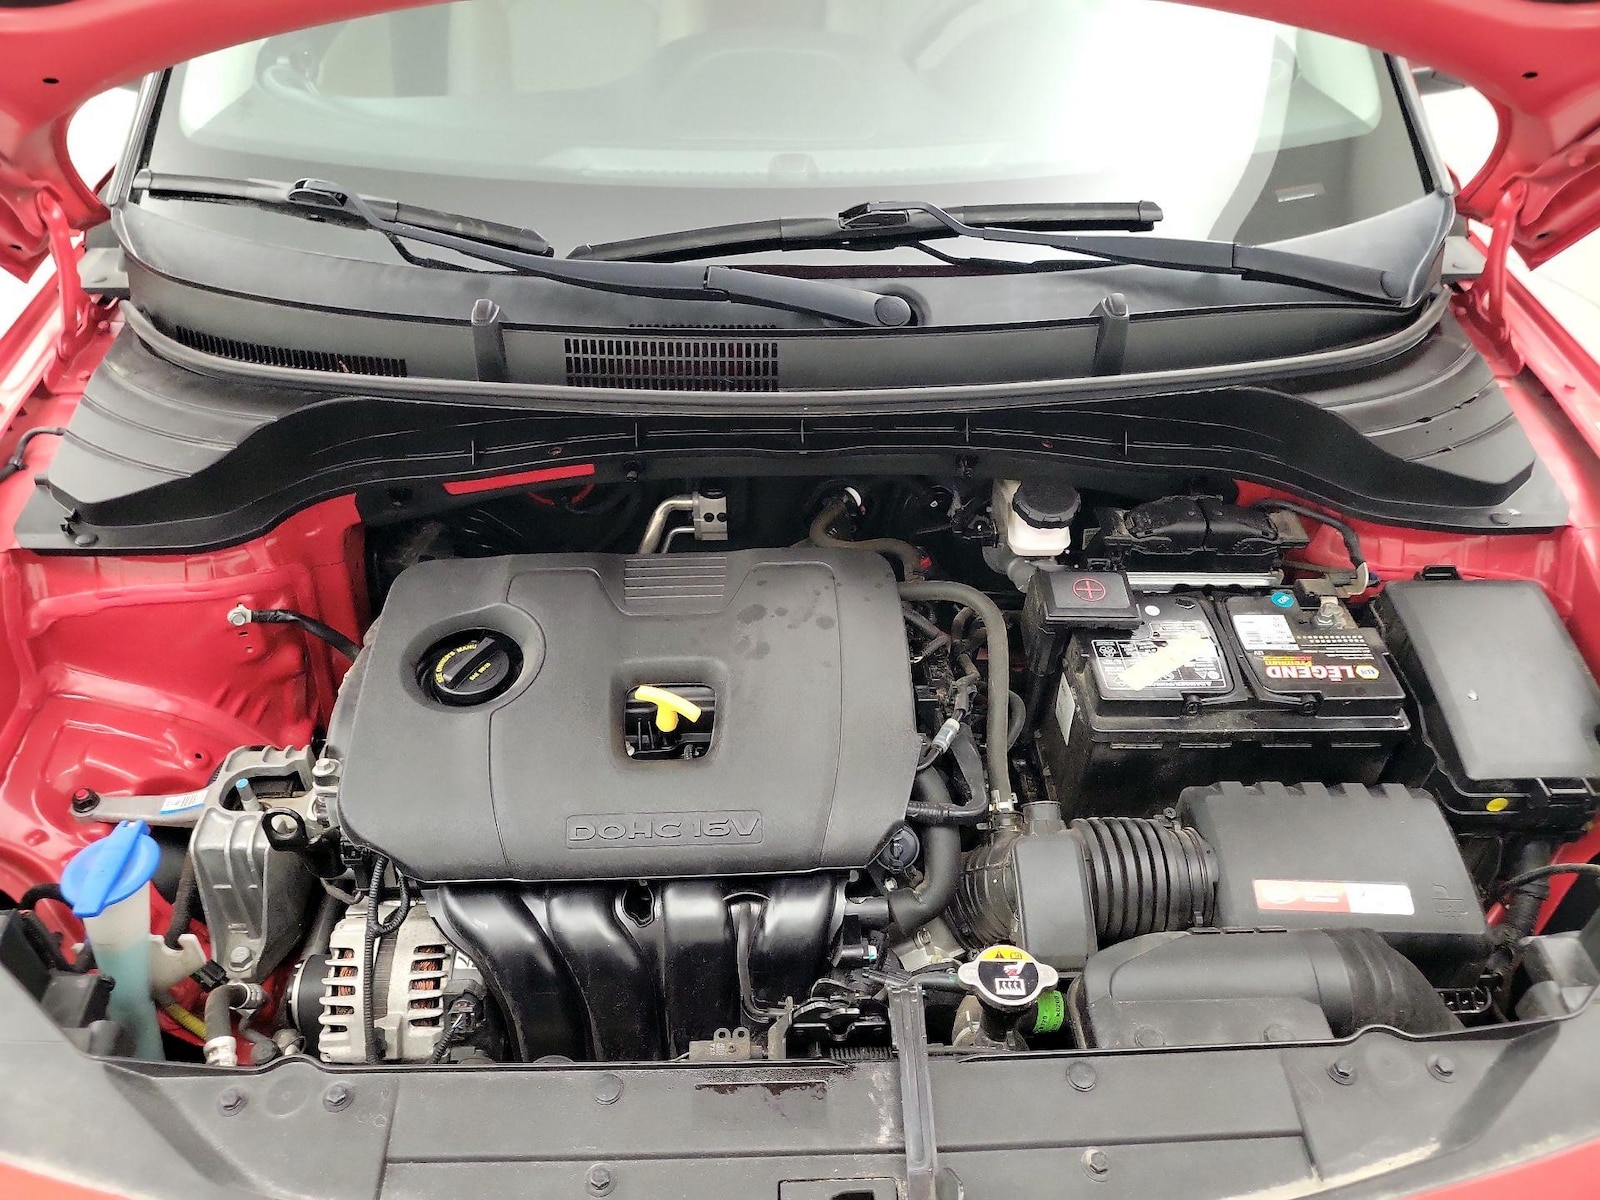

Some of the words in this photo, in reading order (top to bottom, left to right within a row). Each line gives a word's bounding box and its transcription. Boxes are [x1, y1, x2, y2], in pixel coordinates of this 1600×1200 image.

[1265, 665, 1356, 679] LEGEND
[568, 821, 682, 842] DOHC
[694, 818, 760, 838] 16V
